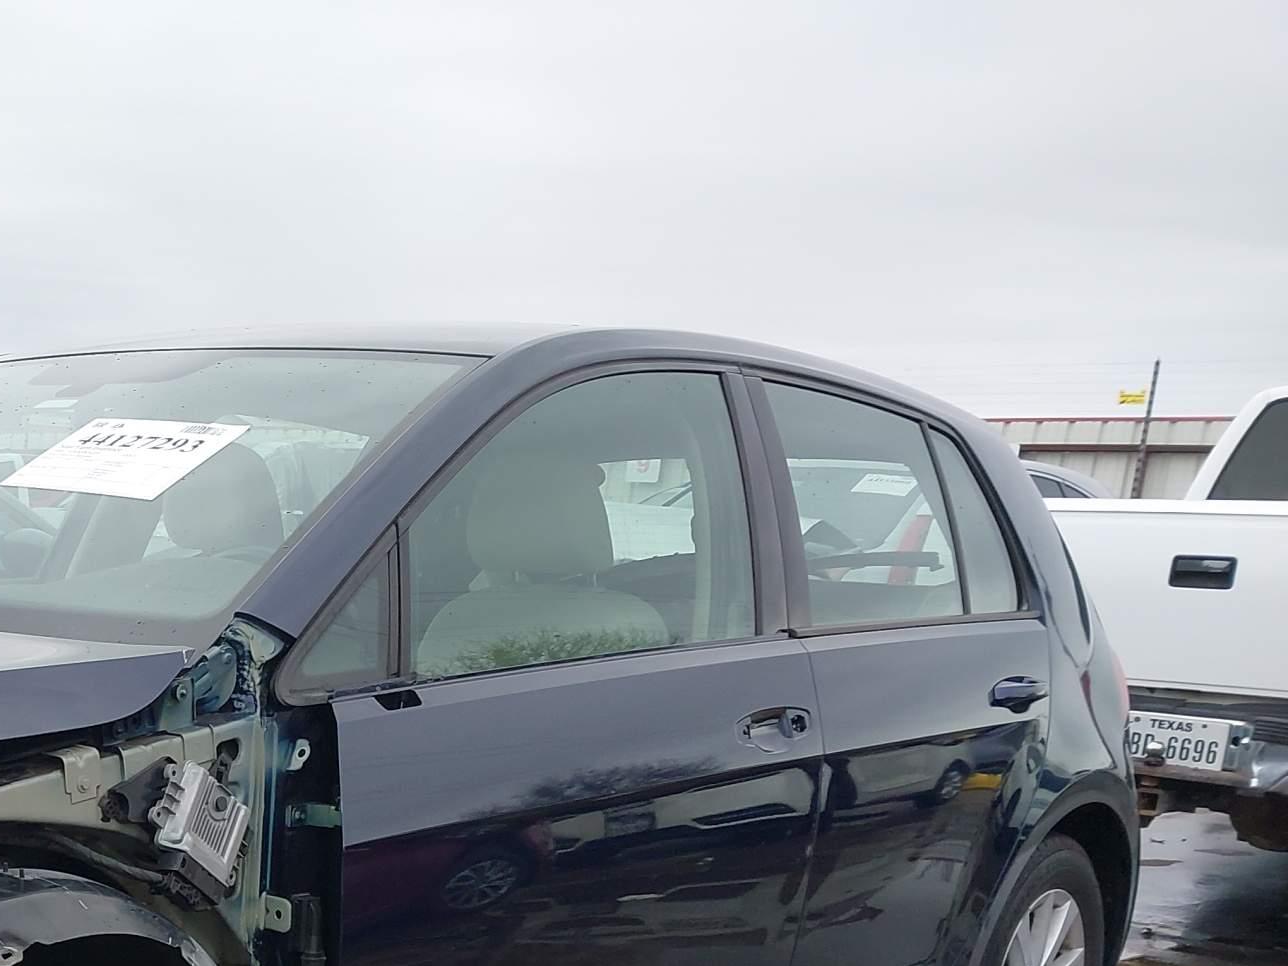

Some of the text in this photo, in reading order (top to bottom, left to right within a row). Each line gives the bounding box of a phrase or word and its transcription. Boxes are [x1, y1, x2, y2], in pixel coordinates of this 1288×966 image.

[78, 432, 206, 453] 44127293
[1149, 718, 1193, 732] TEXAS
[1166, 735, 1219, 765] 6696
